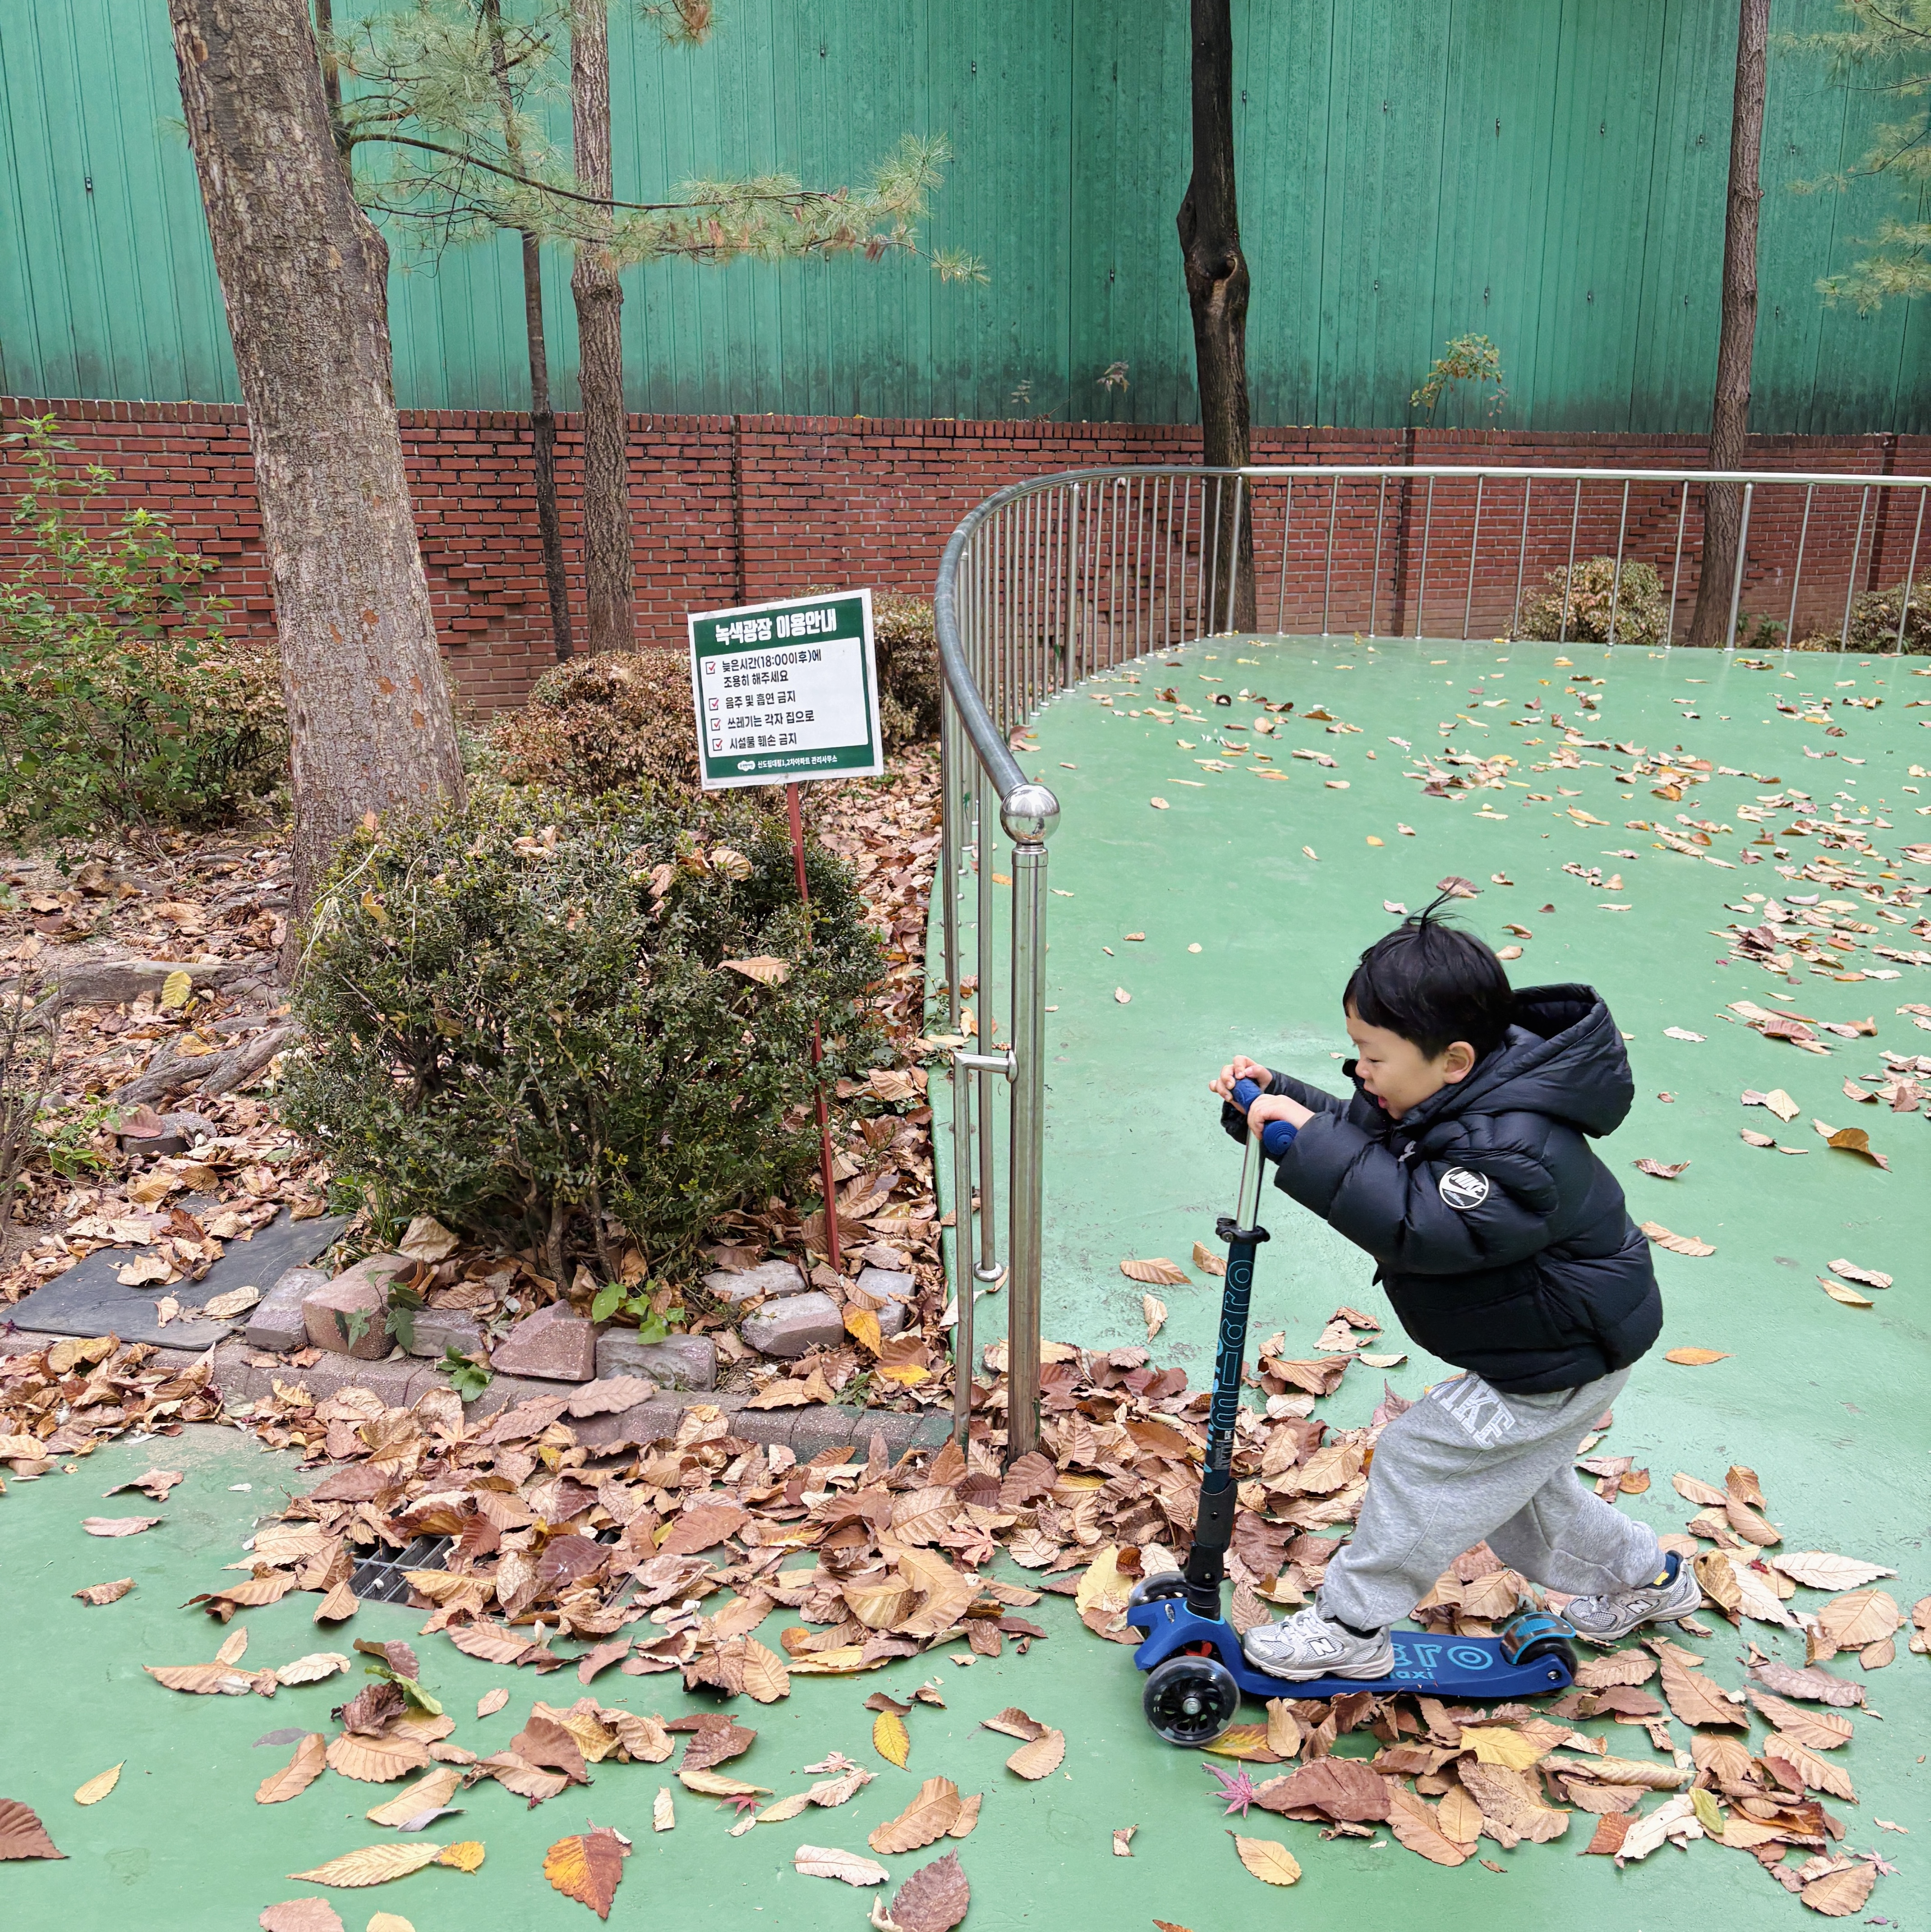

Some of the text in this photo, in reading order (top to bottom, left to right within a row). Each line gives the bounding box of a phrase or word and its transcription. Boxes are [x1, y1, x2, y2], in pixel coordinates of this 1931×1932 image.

[716, 608, 837, 645] 녹색광장 이용안내
[724, 670, 789, 688] 조용히 해주세요
[725, 690, 796, 709] 음주 및 흡연 금지
[728, 710, 815, 729] 쓰레기는 각자 집으로
[729, 733, 797, 749] 시설물 훼손 금지
[1450, 1171, 1486, 1196] NIKE
[1210, 1260, 1253, 1430] micro
